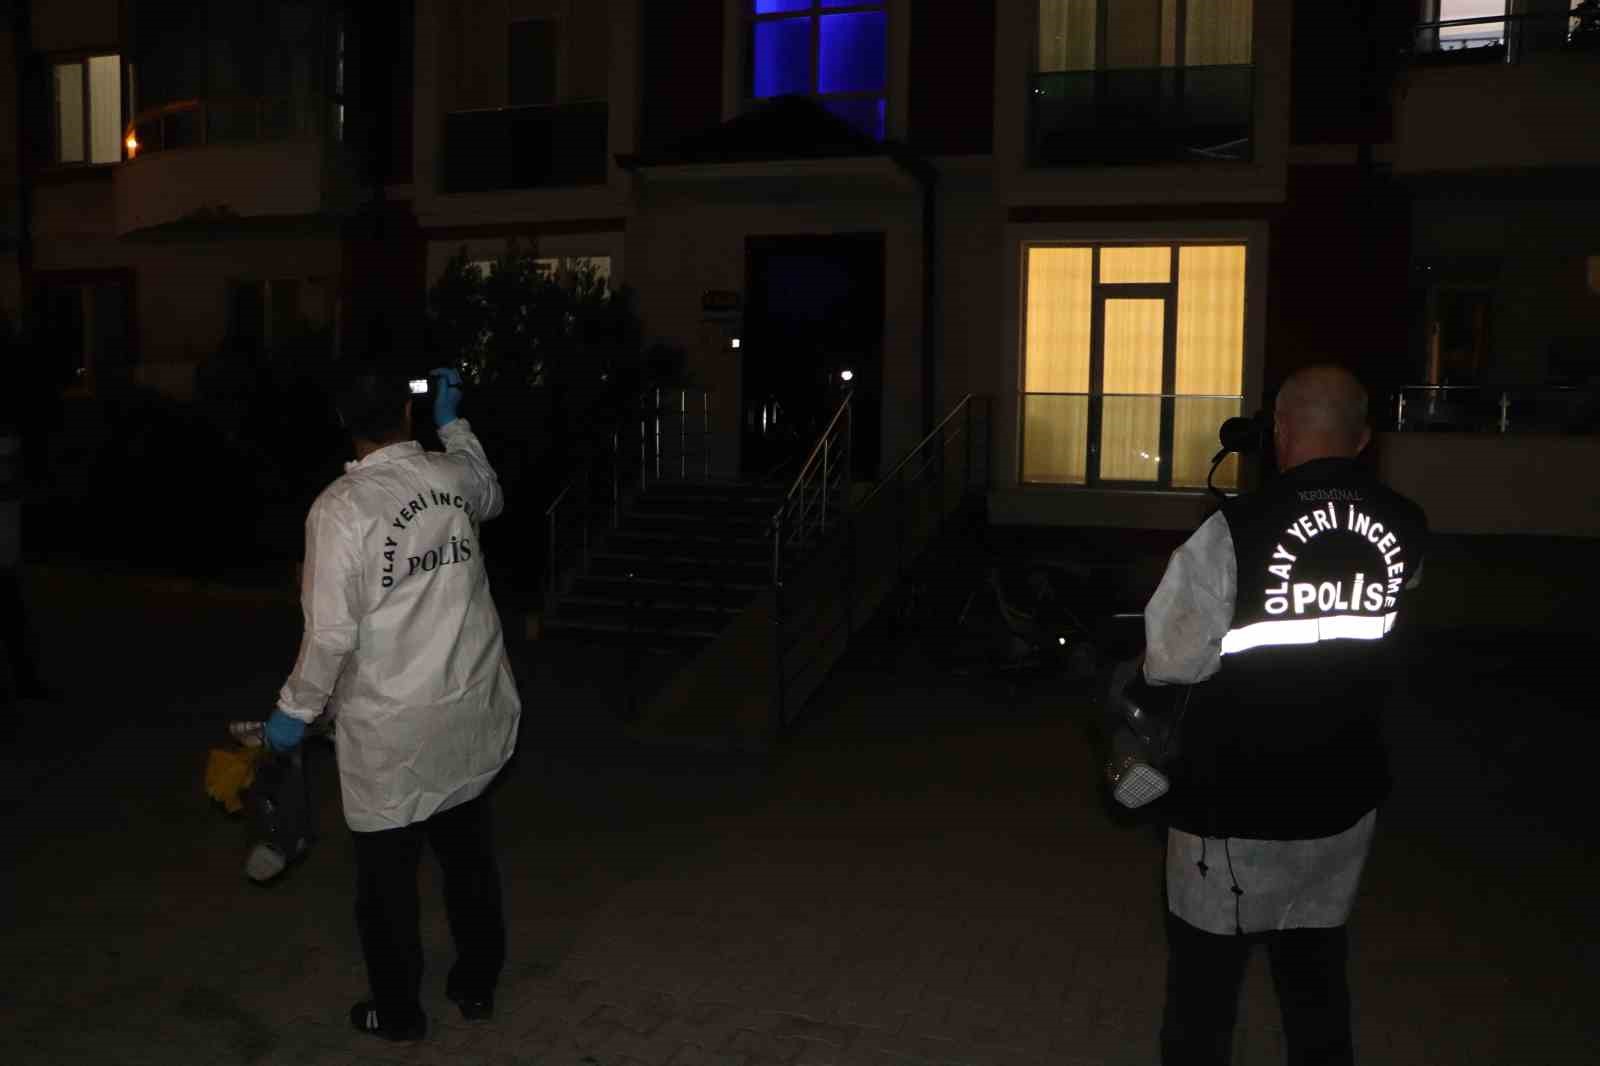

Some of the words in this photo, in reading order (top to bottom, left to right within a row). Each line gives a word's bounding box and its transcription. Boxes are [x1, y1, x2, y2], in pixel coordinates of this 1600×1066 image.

[382, 536, 398, 588] OLAY
[407, 536, 472, 576] POLİS
[1264, 544, 1297, 615] OLAY
[1287, 501, 1338, 544] YERİ
[1347, 504, 1405, 609] İNCELEME
[1293, 572, 1384, 615] POLİS
